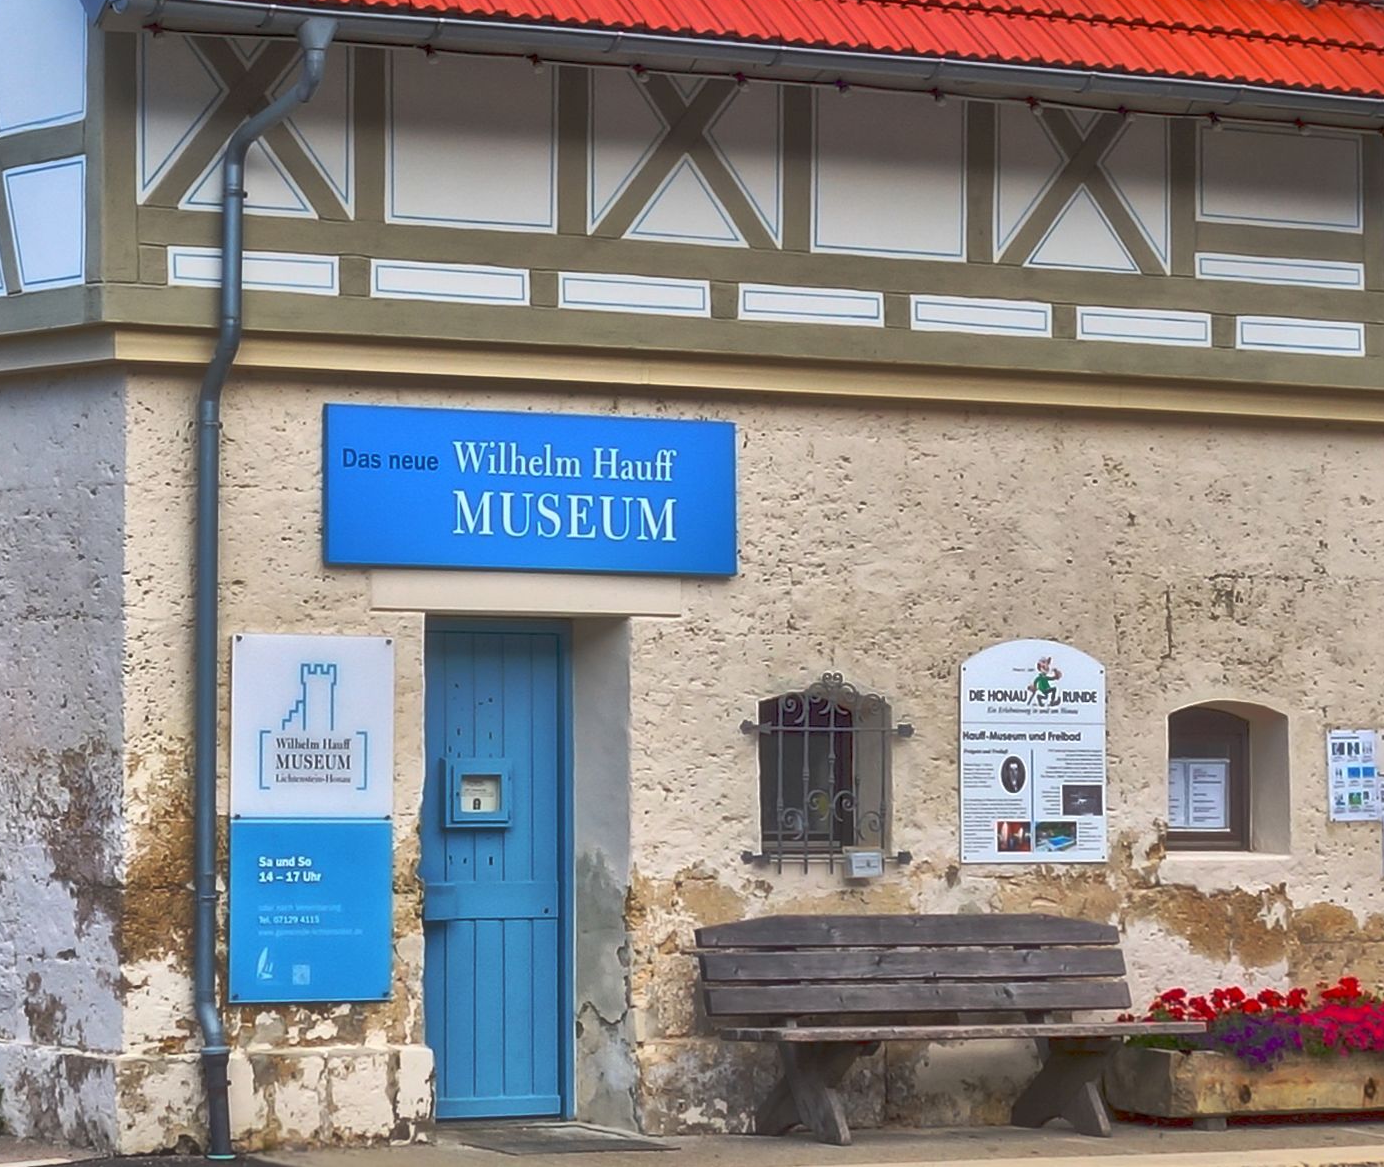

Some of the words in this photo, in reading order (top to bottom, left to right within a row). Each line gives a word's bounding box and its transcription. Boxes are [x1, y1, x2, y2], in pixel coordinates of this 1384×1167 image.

[342, 447, 383, 471] Das
[388, 450, 440, 472] neue
[452, 440, 582, 478] Wilhelm
[592, 447, 678, 482] Hauff
[452, 489, 678, 543] MUSEUM
[969, 689, 985, 702] DIE
[988, 689, 1028, 703] HONAU
[1062, 690, 1098, 703] RUNDE
[962, 730, 1027, 742] Hauff-Museum
[1029, 731, 1046, 742] und
[1048, 731, 1082, 742] Freibad
[276, 737, 320, 750] Wilhelm
[323, 737, 352, 750] Hauff
[275, 753, 352, 770] MUSEUM
[258, 856, 274, 867] Sa
[275, 856, 295, 867] und
[297, 856, 313, 867] So
[258, 871, 274, 882] 14
[285, 871, 301, 882] 17
[302, 871, 322, 882] Uhr
